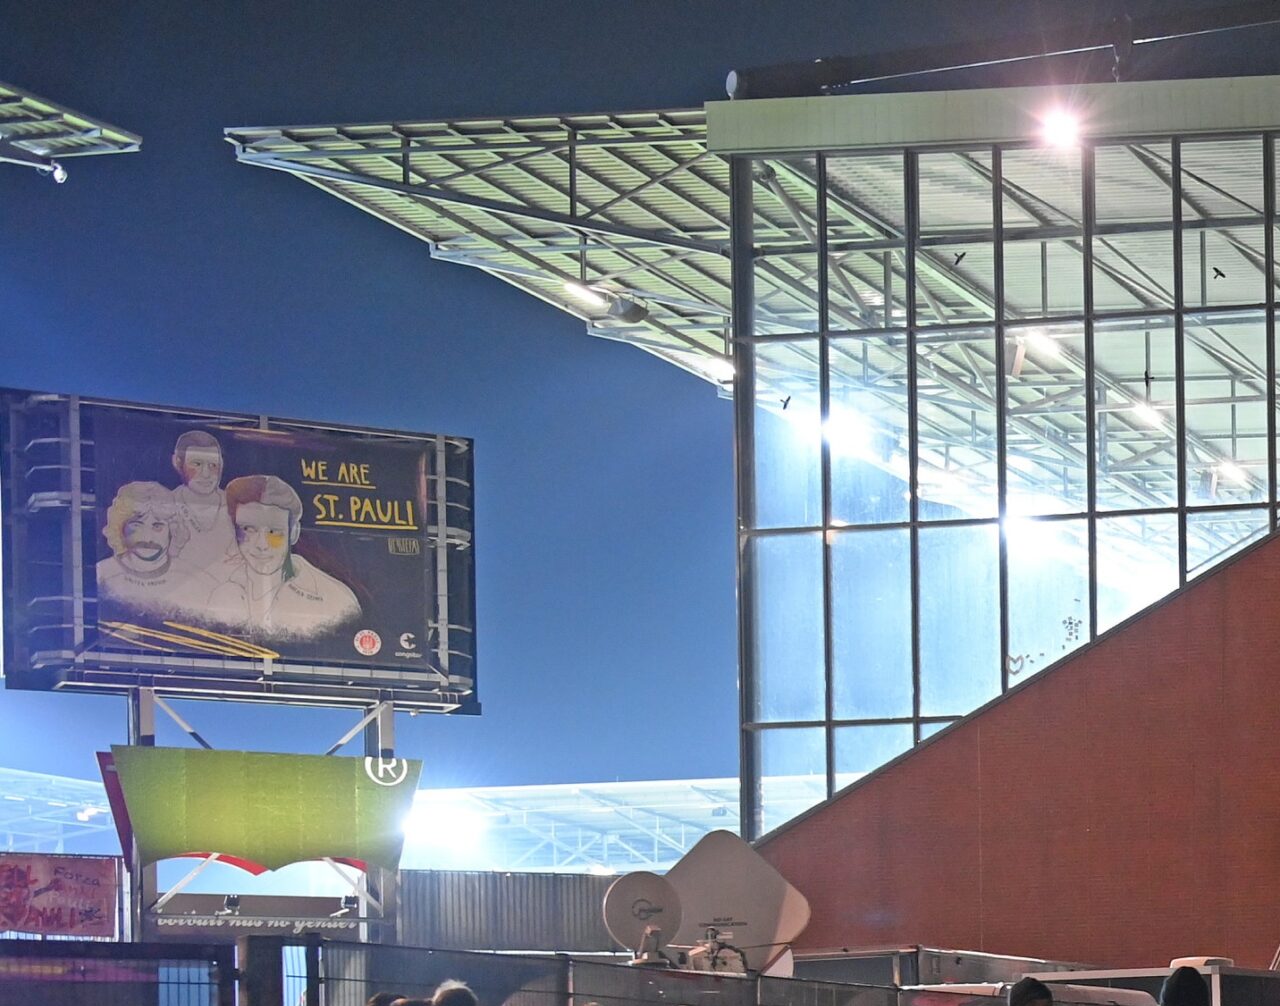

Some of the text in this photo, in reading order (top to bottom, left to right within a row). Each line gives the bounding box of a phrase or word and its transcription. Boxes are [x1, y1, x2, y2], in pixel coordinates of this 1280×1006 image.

[301, 458, 370, 484] WE ARE
[313, 494, 414, 525] ST. PAULI
